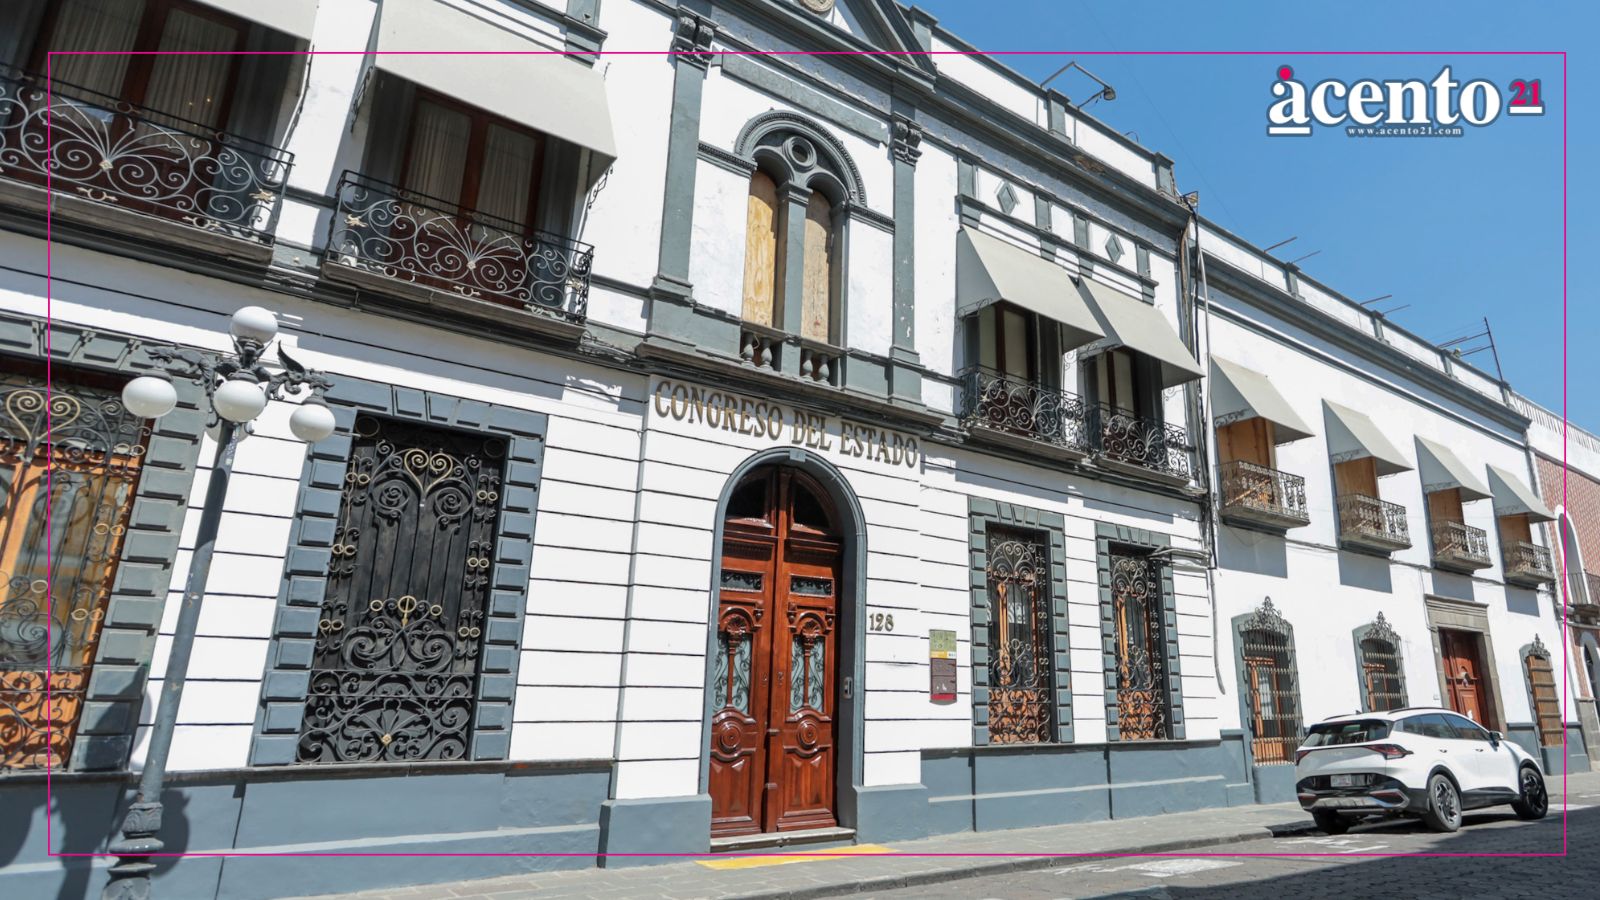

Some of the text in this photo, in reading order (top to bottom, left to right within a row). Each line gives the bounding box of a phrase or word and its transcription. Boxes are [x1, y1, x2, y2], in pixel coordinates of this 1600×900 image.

[655, 380, 918, 469] CONGRESO DEL ESTADO
[869, 613, 894, 632] 128
